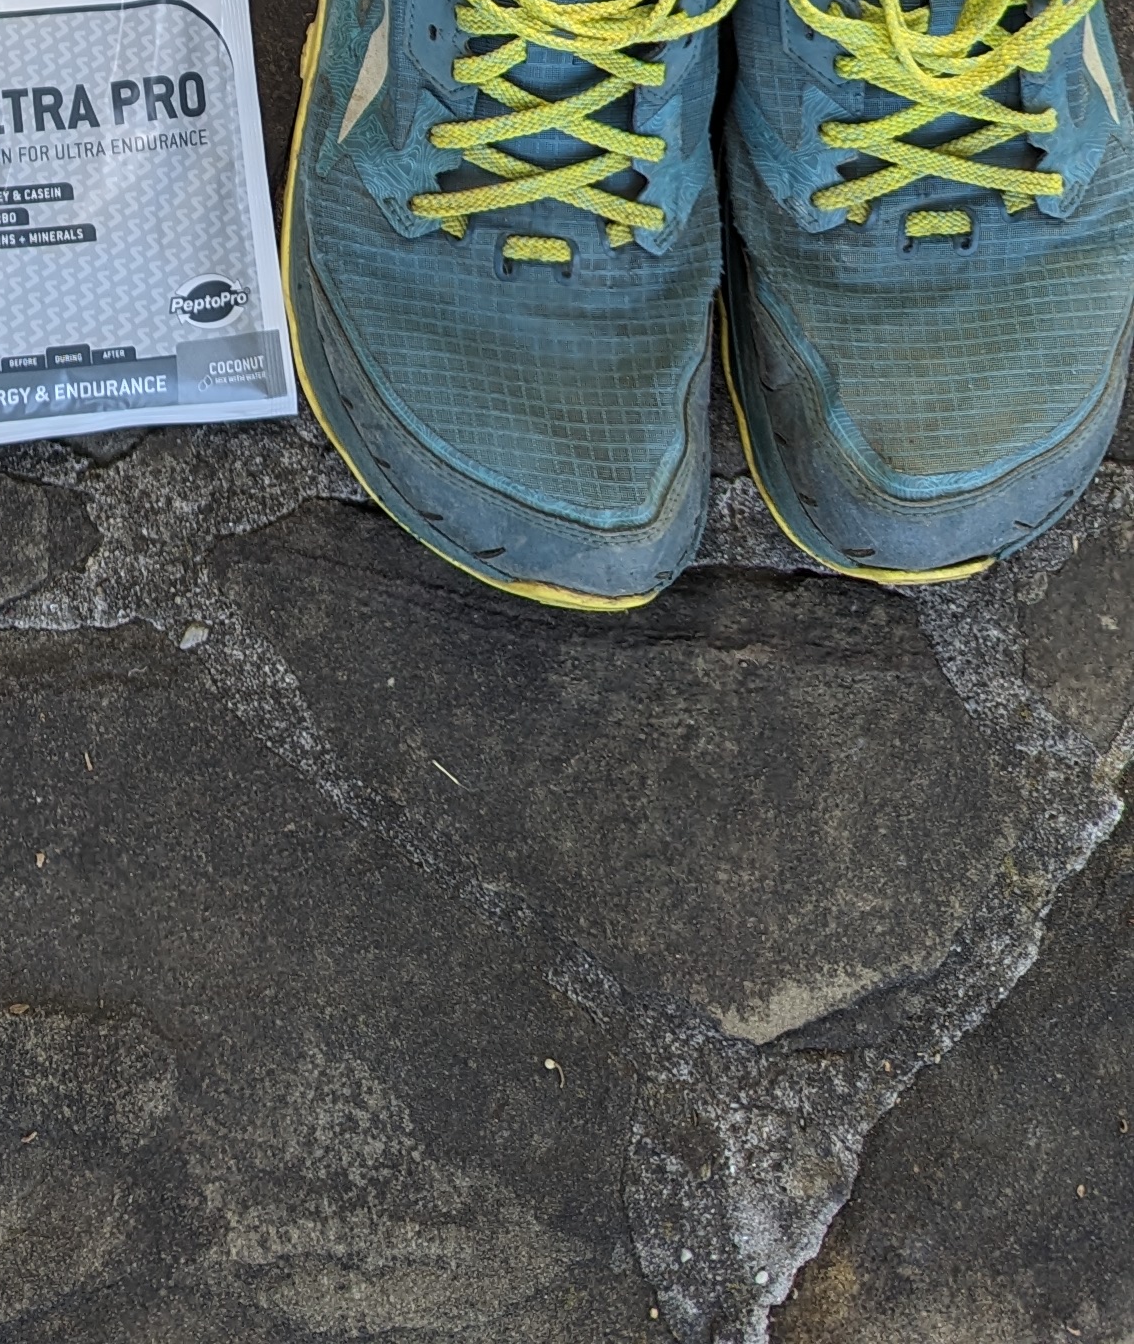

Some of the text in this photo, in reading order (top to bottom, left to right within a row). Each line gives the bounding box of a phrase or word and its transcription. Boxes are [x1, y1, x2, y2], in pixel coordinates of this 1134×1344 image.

[111, 71, 206, 126] PRO
[18, 144, 50, 163] FOR
[55, 140, 106, 159] ULTRA
[111, 129, 208, 155] ENDURANCE
[13, 190, 22, 201] &
[24, 187, 62, 200] CASEIN
[29, 228, 84, 243] MINERALS
[170, 290, 249, 314] PeptoPro
[9, 357, 37, 367] BEFORE
[103, 349, 125, 358] AFTER
[209, 355, 264, 375] COCONUT
[35, 386, 50, 402] &
[54, 375, 167, 399] ENDURANCE
